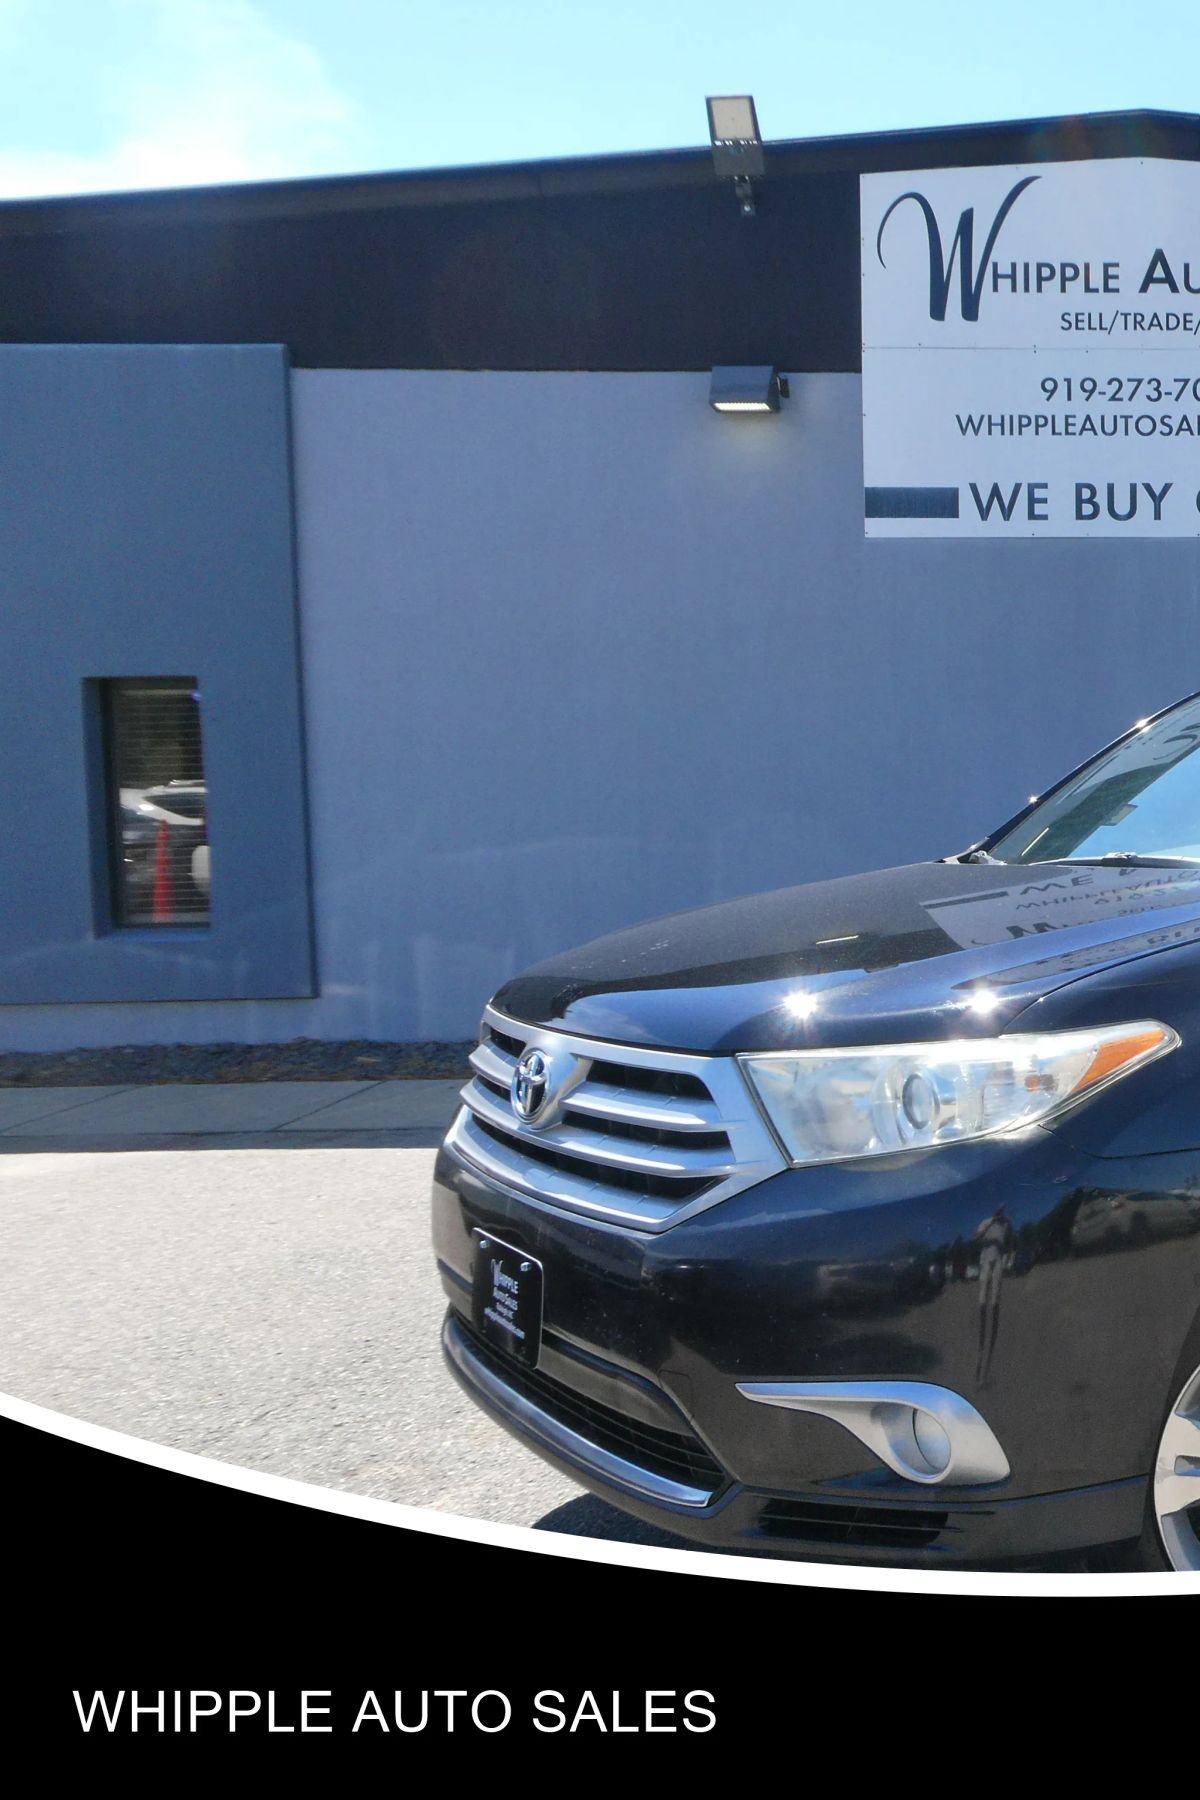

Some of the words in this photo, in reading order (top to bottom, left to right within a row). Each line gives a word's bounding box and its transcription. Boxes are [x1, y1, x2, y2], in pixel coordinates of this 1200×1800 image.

[876, 175, 1121, 322] WHIPPLE
[969, 482, 1049, 521] WE
[1074, 482, 1173, 521] BUY
